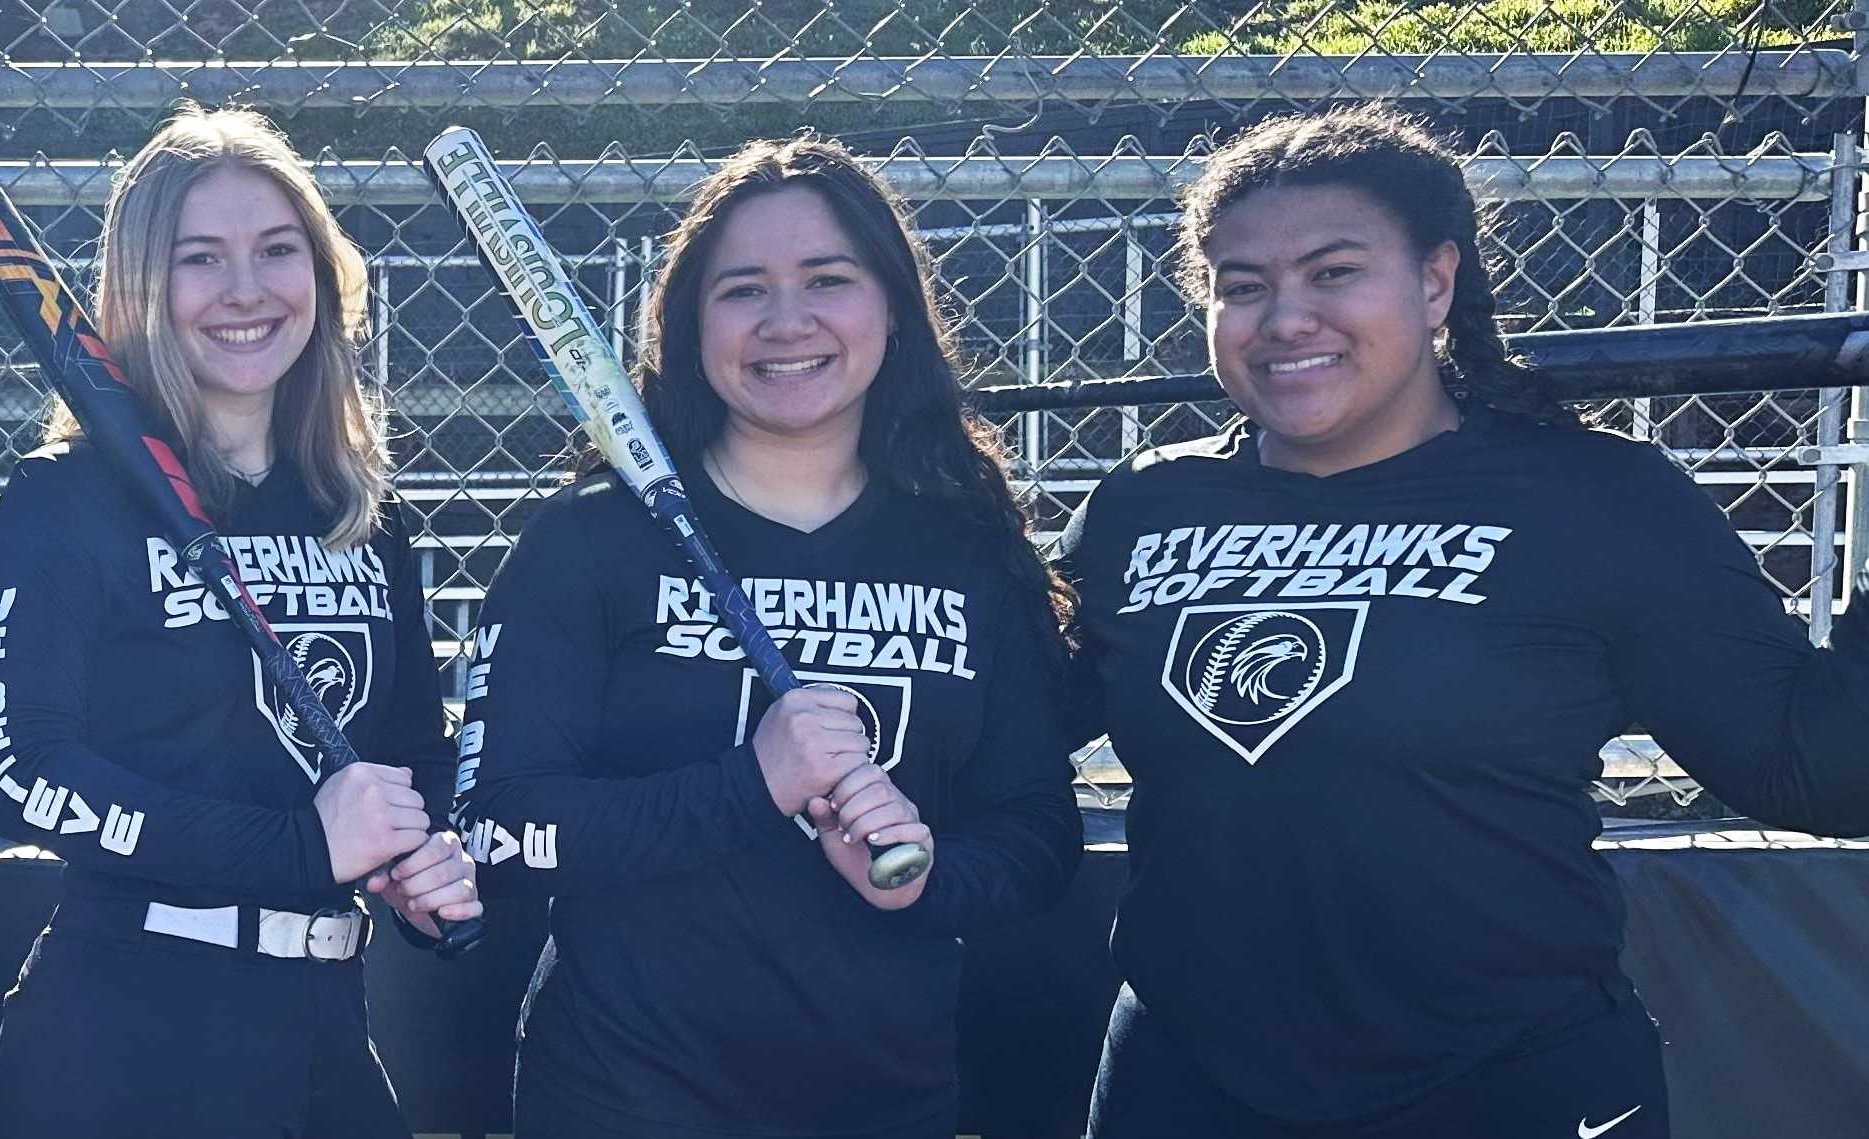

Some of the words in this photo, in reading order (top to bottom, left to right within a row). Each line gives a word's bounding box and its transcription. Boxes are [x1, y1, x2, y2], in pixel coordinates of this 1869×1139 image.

[437, 141, 590, 356] LOUISVILLE
[1123, 523, 1514, 584] RIVERHAWKS
[655, 574, 967, 644] RIERHAWKS
[1116, 566, 1488, 616] SOFTBALL
